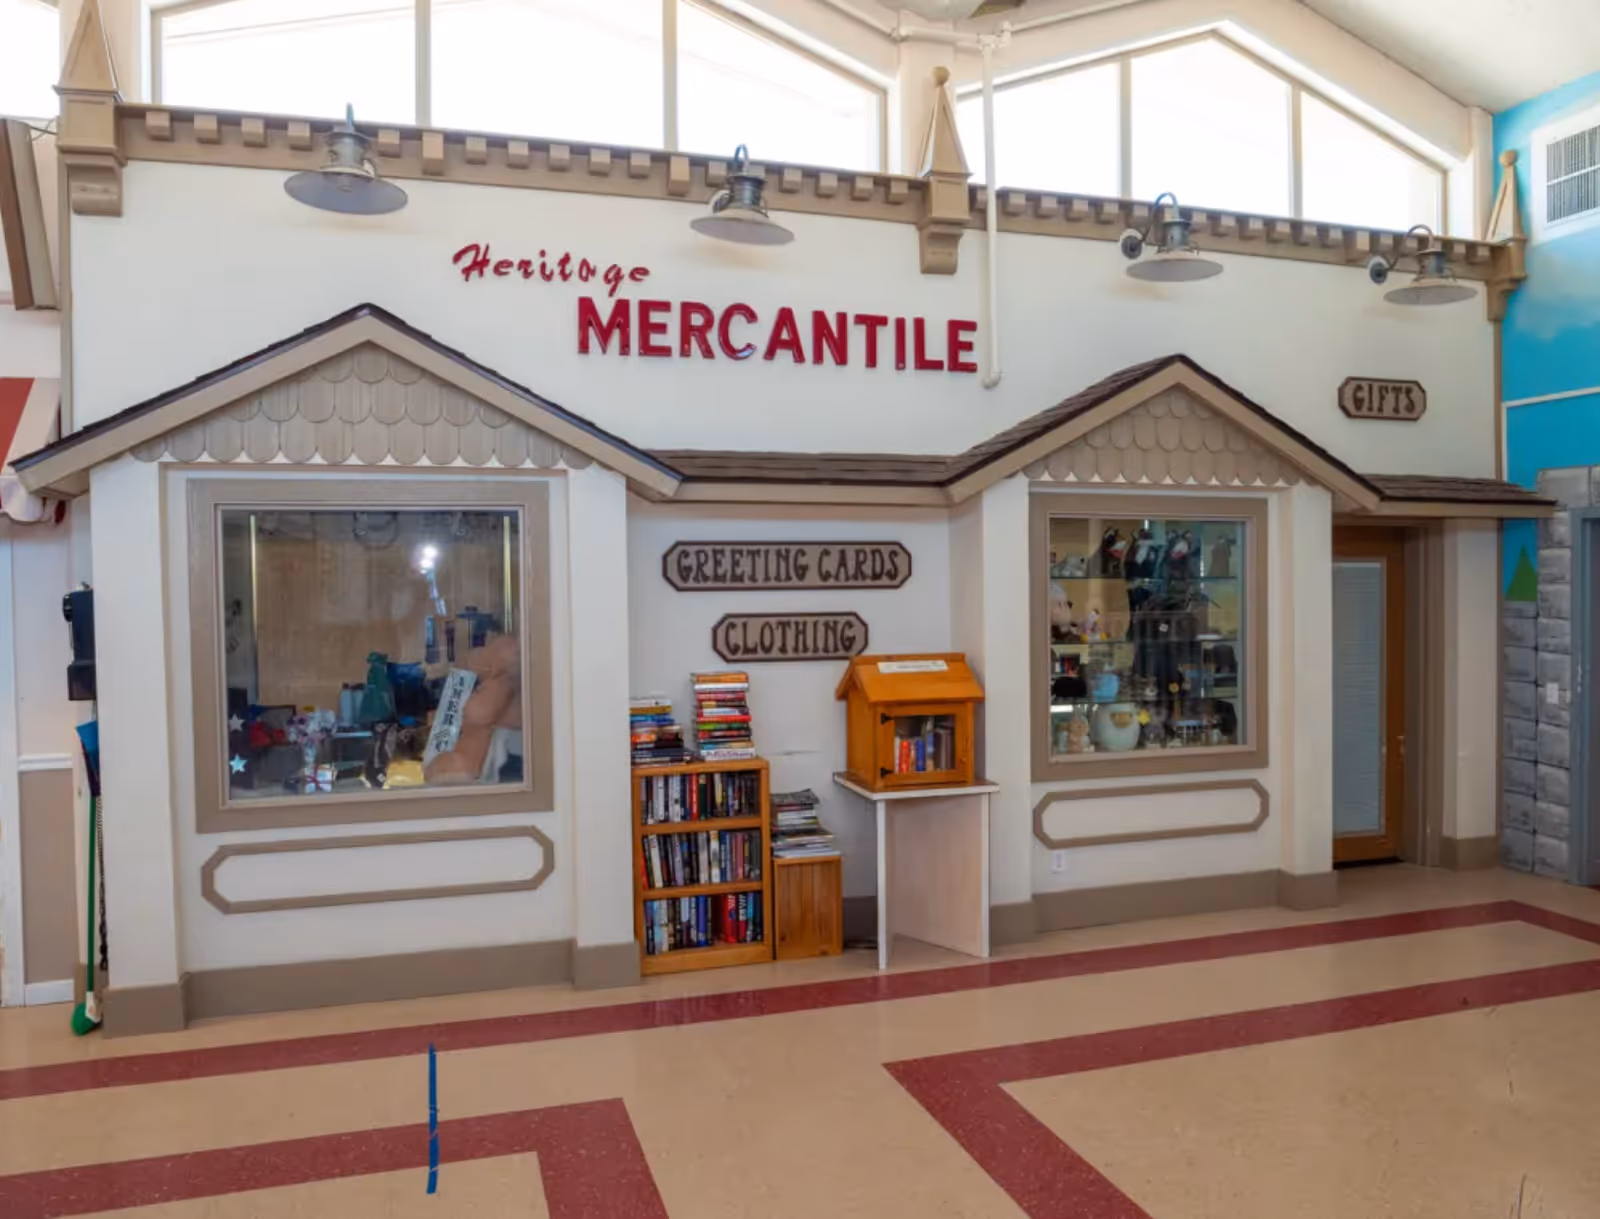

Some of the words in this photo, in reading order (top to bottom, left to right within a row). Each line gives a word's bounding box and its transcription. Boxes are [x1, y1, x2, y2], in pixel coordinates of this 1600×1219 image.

[452, 243, 650, 296] Heritage
[578, 297, 977, 372] MERCANTILE
[1352, 383, 1415, 414] GIFTS
[676, 548, 809, 583] GREETING
[817, 549, 899, 582] CARDS
[724, 620, 857, 654] CLOTHING
